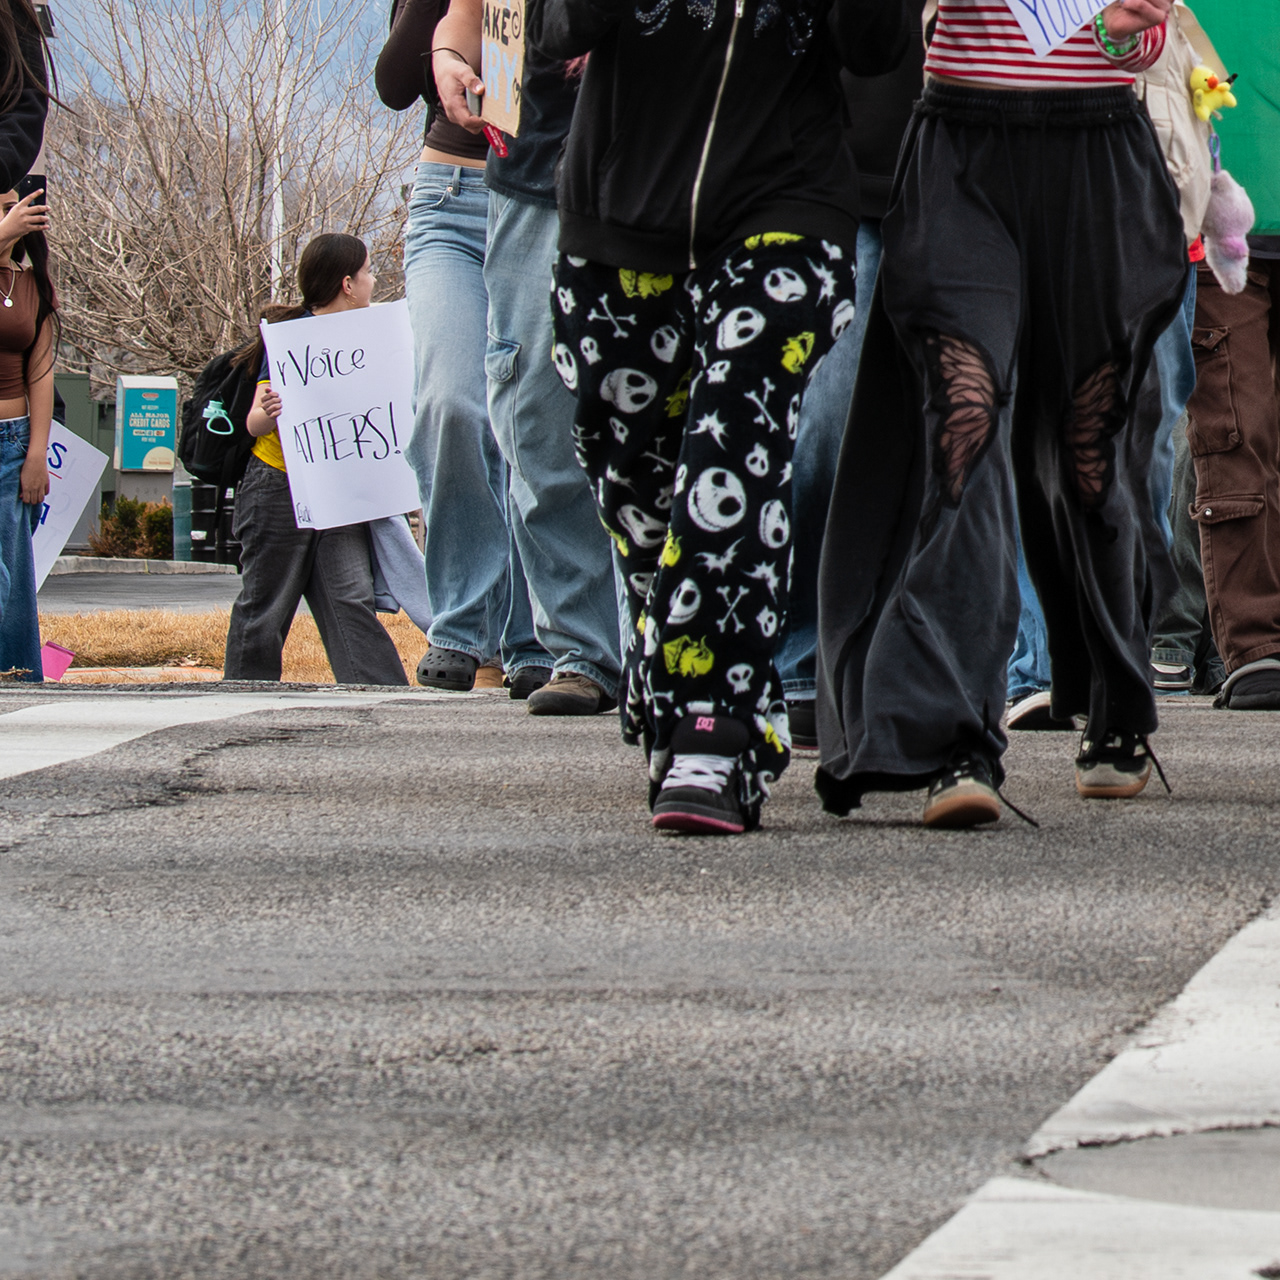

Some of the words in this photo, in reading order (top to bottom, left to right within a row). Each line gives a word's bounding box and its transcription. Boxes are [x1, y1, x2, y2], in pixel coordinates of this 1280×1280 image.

[288, 345, 365, 386] Voice
[129, 418, 149, 428] CREDIT
[151, 418, 170, 428] CARDS
